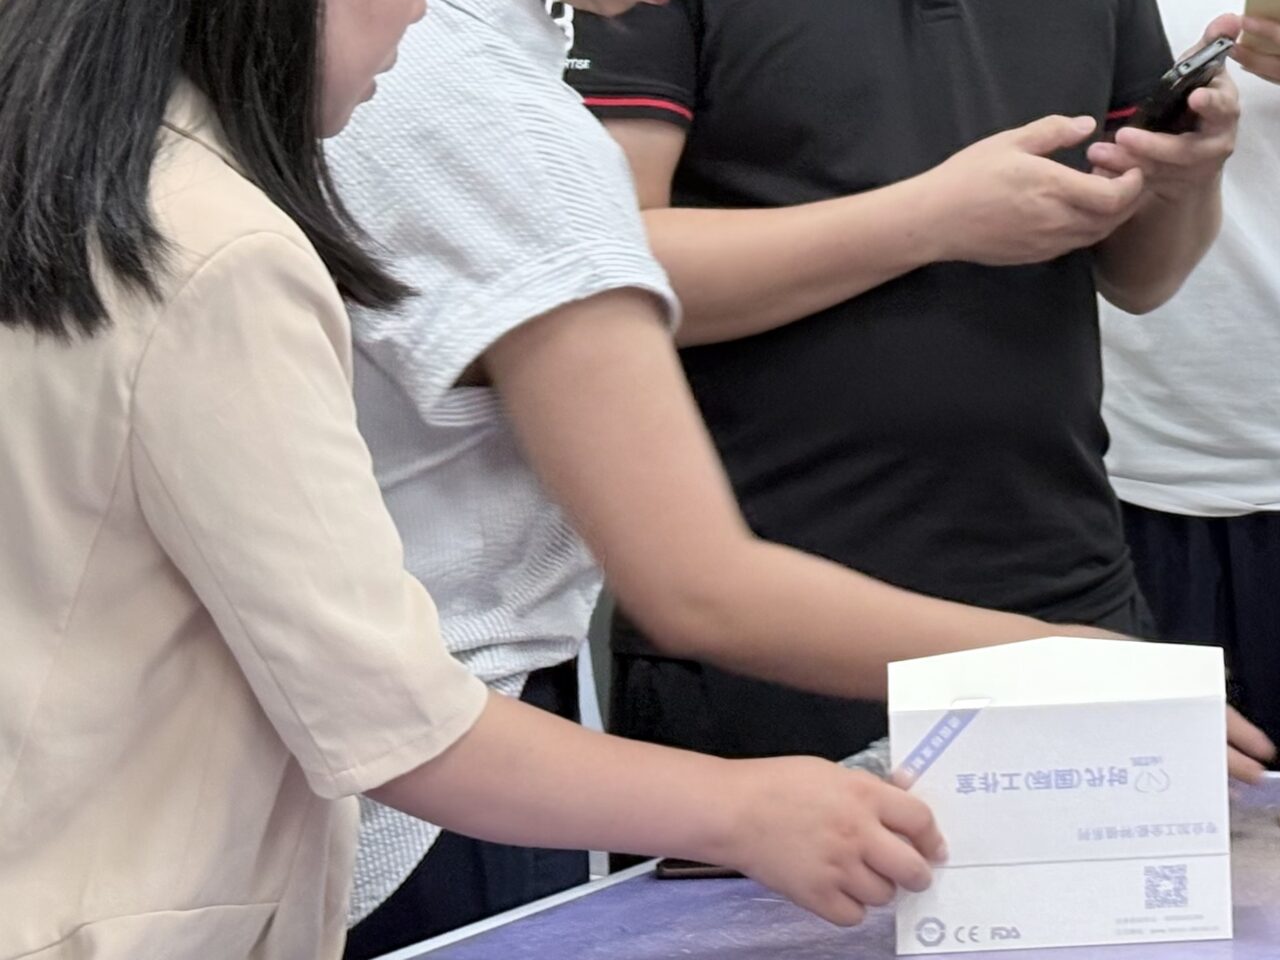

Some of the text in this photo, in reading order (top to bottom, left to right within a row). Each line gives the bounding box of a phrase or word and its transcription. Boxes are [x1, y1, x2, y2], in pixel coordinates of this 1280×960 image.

[955, 766, 1128, 795] 时代(国际)工作室
[954, 925, 980, 944] CE
[990, 926, 1021, 941] FDA
